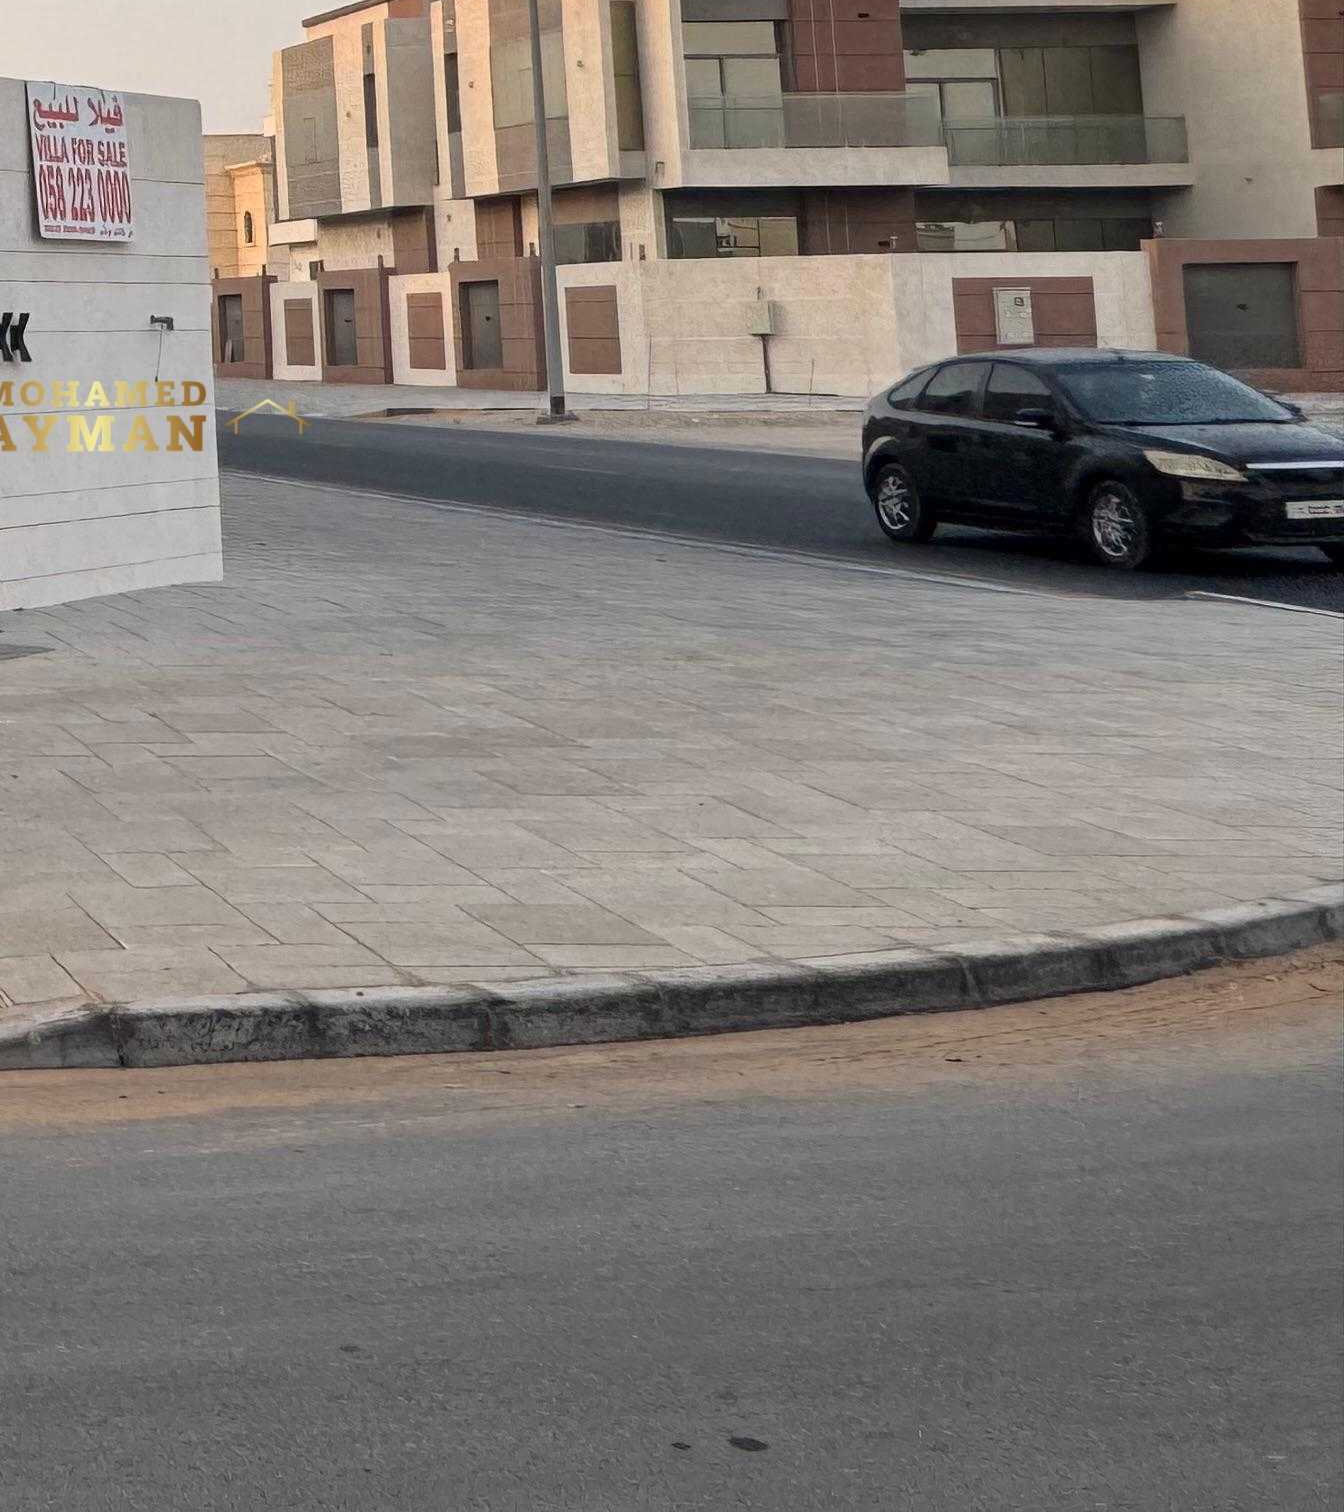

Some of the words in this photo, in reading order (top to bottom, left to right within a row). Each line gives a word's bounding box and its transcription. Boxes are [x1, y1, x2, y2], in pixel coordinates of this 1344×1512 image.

[33, 95, 79, 131] للبيع
[87, 95, 123, 133] فيلا
[35, 134, 69, 163] VILLA
[71, 138, 95, 165] FOR
[97, 140, 127, 167] SALE
[97, 169, 131, 224] 0000
